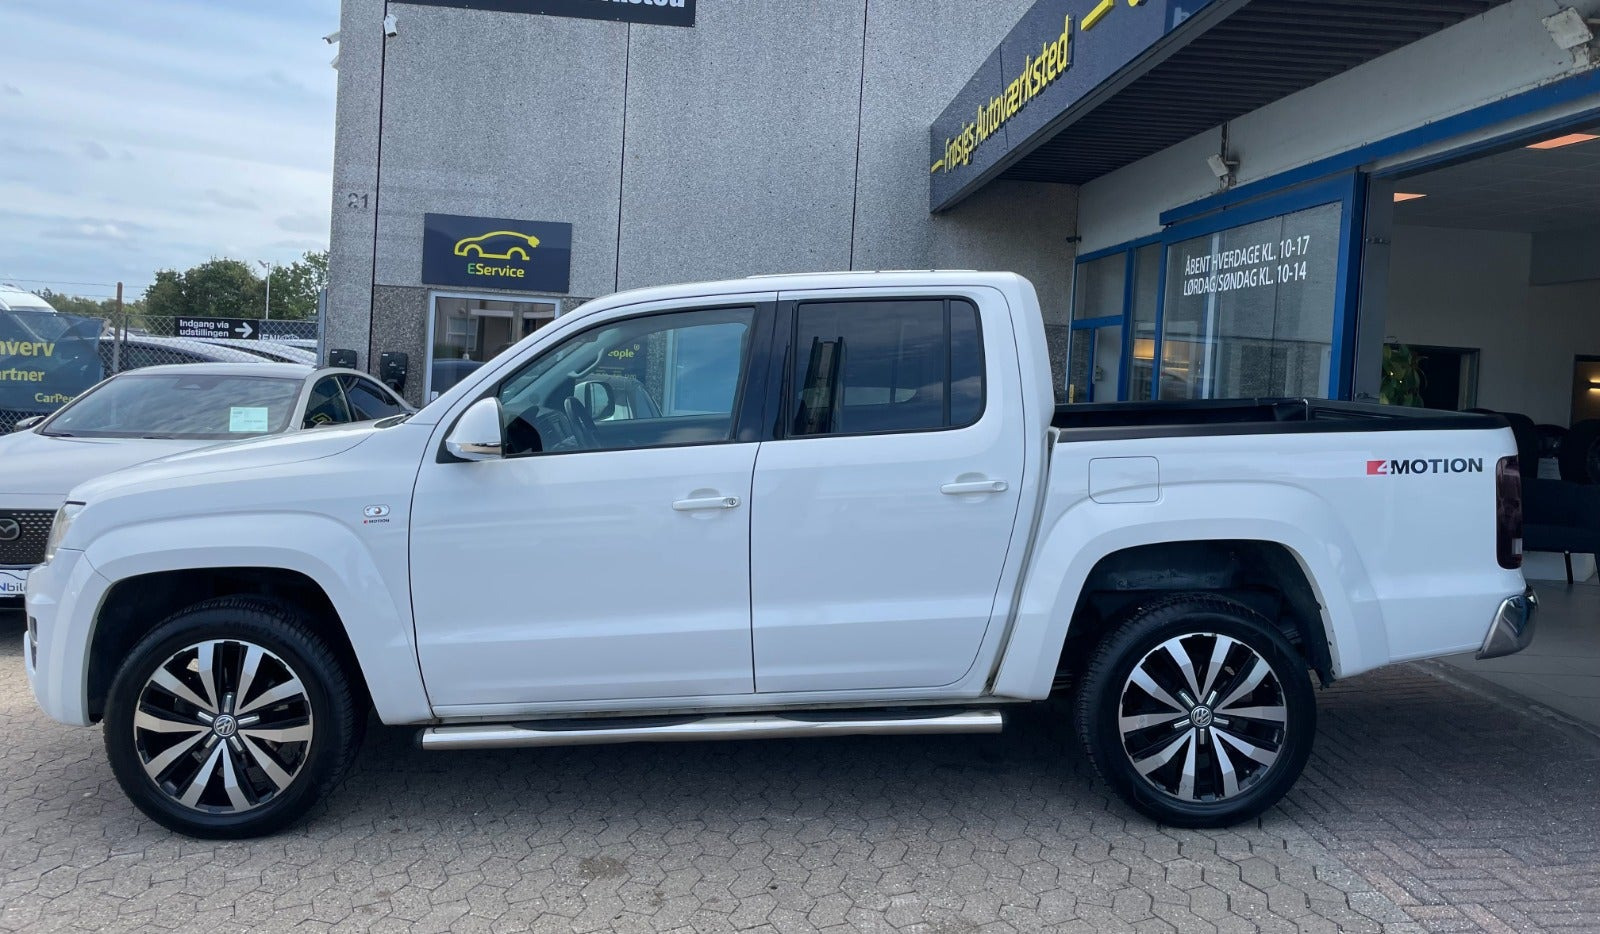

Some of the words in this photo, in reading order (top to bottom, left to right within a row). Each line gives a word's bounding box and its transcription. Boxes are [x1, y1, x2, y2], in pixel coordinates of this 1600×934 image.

[975, 14, 1069, 146] Autoværksted
[1184, 255, 1211, 275] ÅBENT
[1211, 245, 1260, 271] HVERDAGE
[1261, 242, 1276, 262] KL.
[1280, 235, 1310, 259] 10-17
[467, 263, 525, 278] EService
[1183, 268, 1257, 296] LØRDAG/SØNDAG
[1259, 267, 1274, 286] KL.
[1277, 261, 1307, 283] 10-14
[179, 320, 215, 329] Indgang
[216, 321, 229, 329] via
[179, 328, 229, 337] udstillingen
[0, 368, 45, 381] rtner
